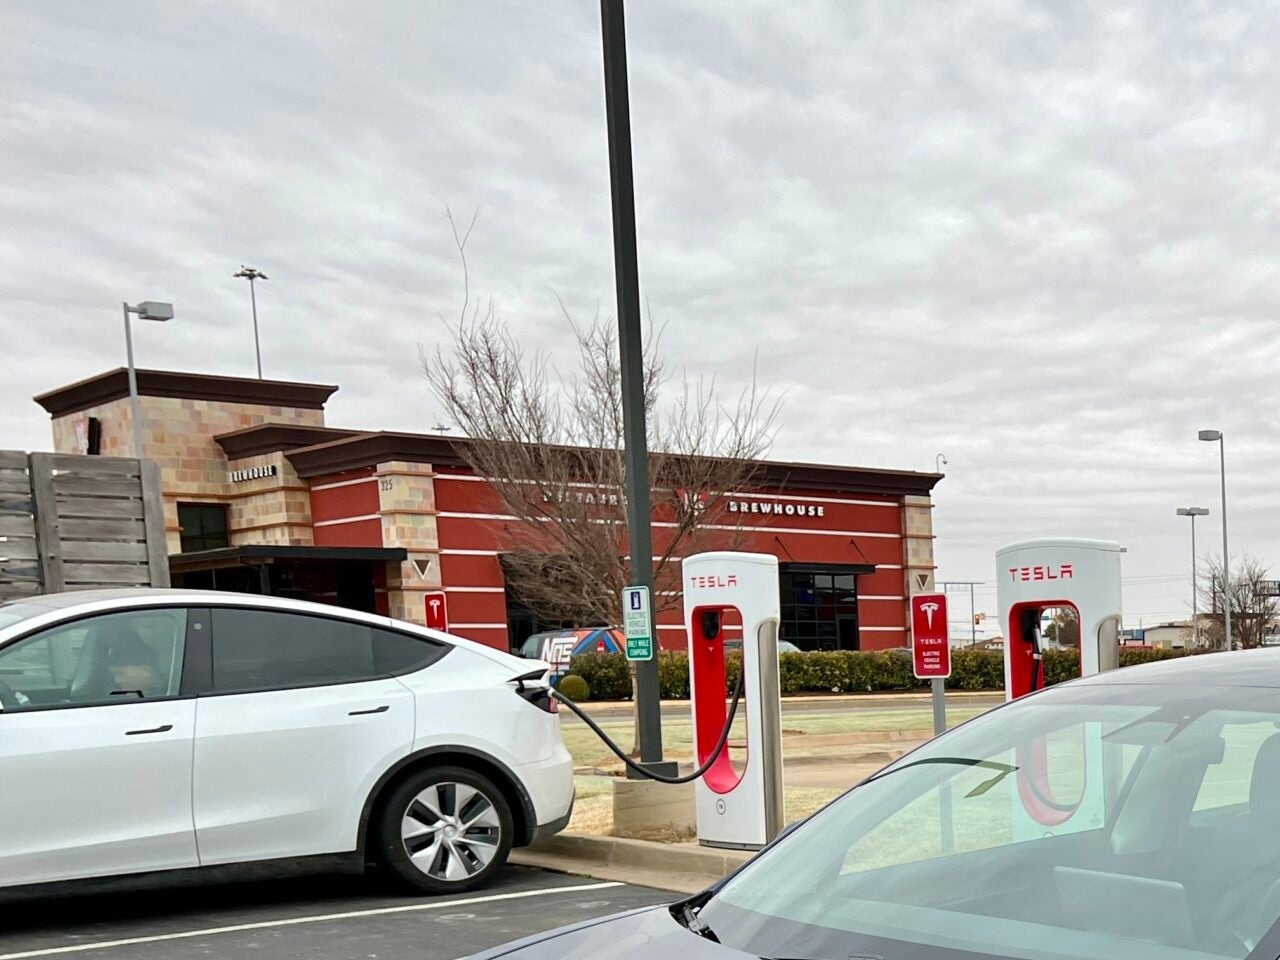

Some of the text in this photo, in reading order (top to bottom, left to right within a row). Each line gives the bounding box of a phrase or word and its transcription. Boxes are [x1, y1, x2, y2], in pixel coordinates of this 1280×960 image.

[381, 479, 393, 491] 325
[729, 501, 825, 517] BREWHOUSE
[1009, 565, 1072, 582] TESLA
[691, 576, 736, 588] TESLA
[920, 638, 942, 646] TESLA
